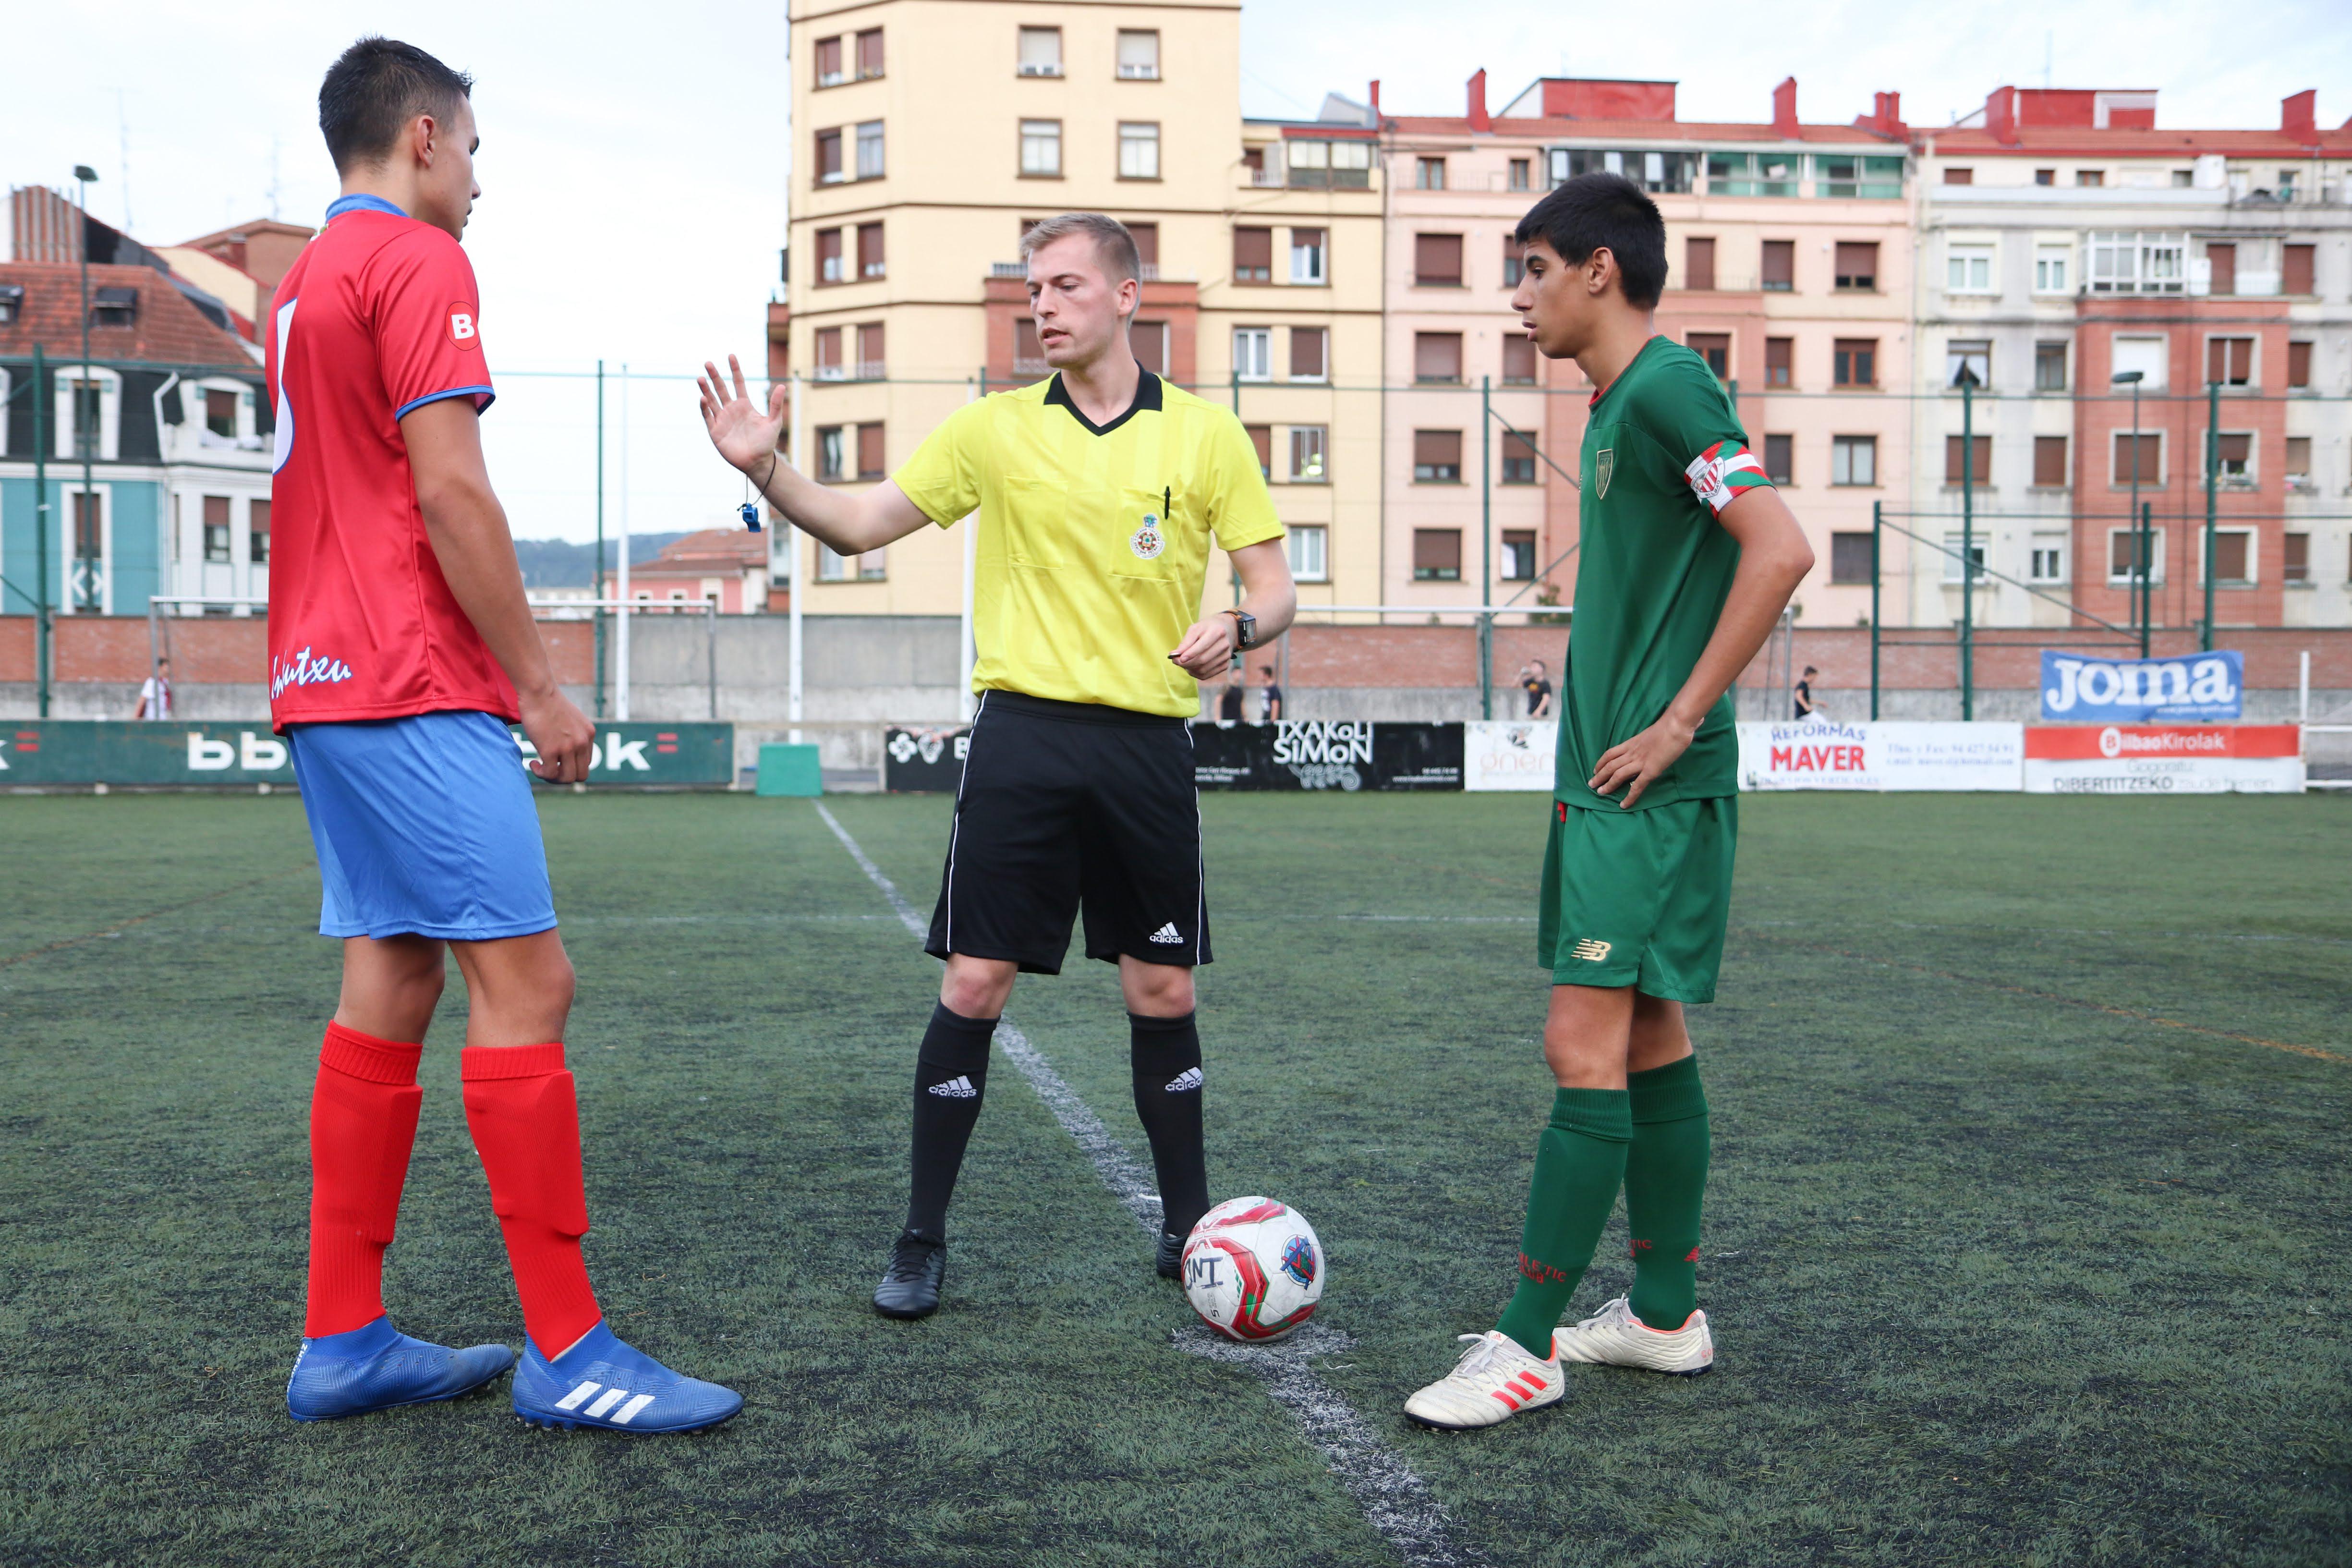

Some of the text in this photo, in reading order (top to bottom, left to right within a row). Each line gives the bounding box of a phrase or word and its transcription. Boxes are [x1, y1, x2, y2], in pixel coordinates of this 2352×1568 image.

[451, 314, 474, 339] B
[2046, 659, 2236, 712] Joma
[1771, 724, 1866, 742] REFORMAS
[188, 731, 294, 771] bb
[1771, 745, 1866, 771] MAVER
[2053, 776, 2174, 790] DIBERTITZEKO
[1150, 935, 1184, 943] adidas
[929, 1086, 977, 1097] adidas
